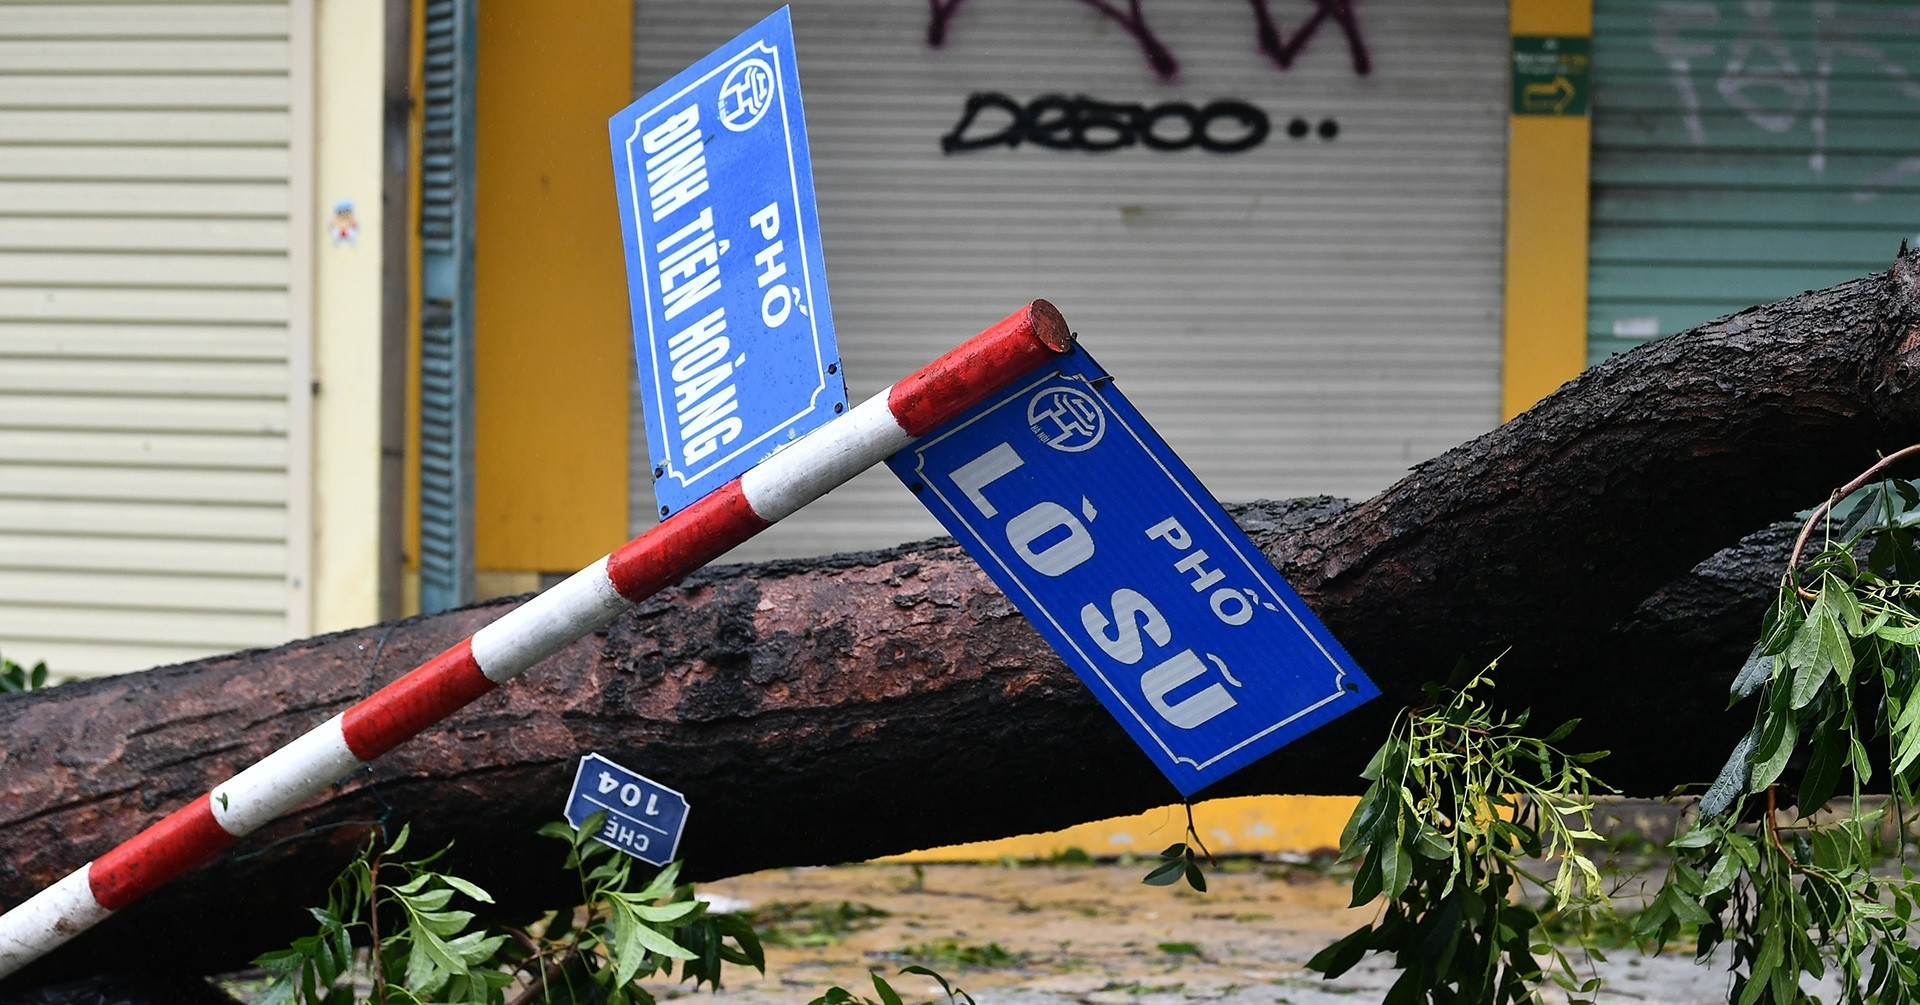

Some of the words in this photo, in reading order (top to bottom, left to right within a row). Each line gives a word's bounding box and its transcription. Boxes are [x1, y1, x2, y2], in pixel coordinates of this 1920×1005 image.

[643, 102, 708, 222] ĐINH
[656, 207, 730, 322] TIÊN
[750, 201, 808, 329] PHỐ
[667, 313, 748, 467] HOÀNG
[948, 441, 1098, 577] LÒ
[1080, 587, 1242, 730] SŨ
[1144, 515, 1279, 626] PHỐ
[598, 771, 660, 816] 104
[603, 815, 650, 853] CHẸ
